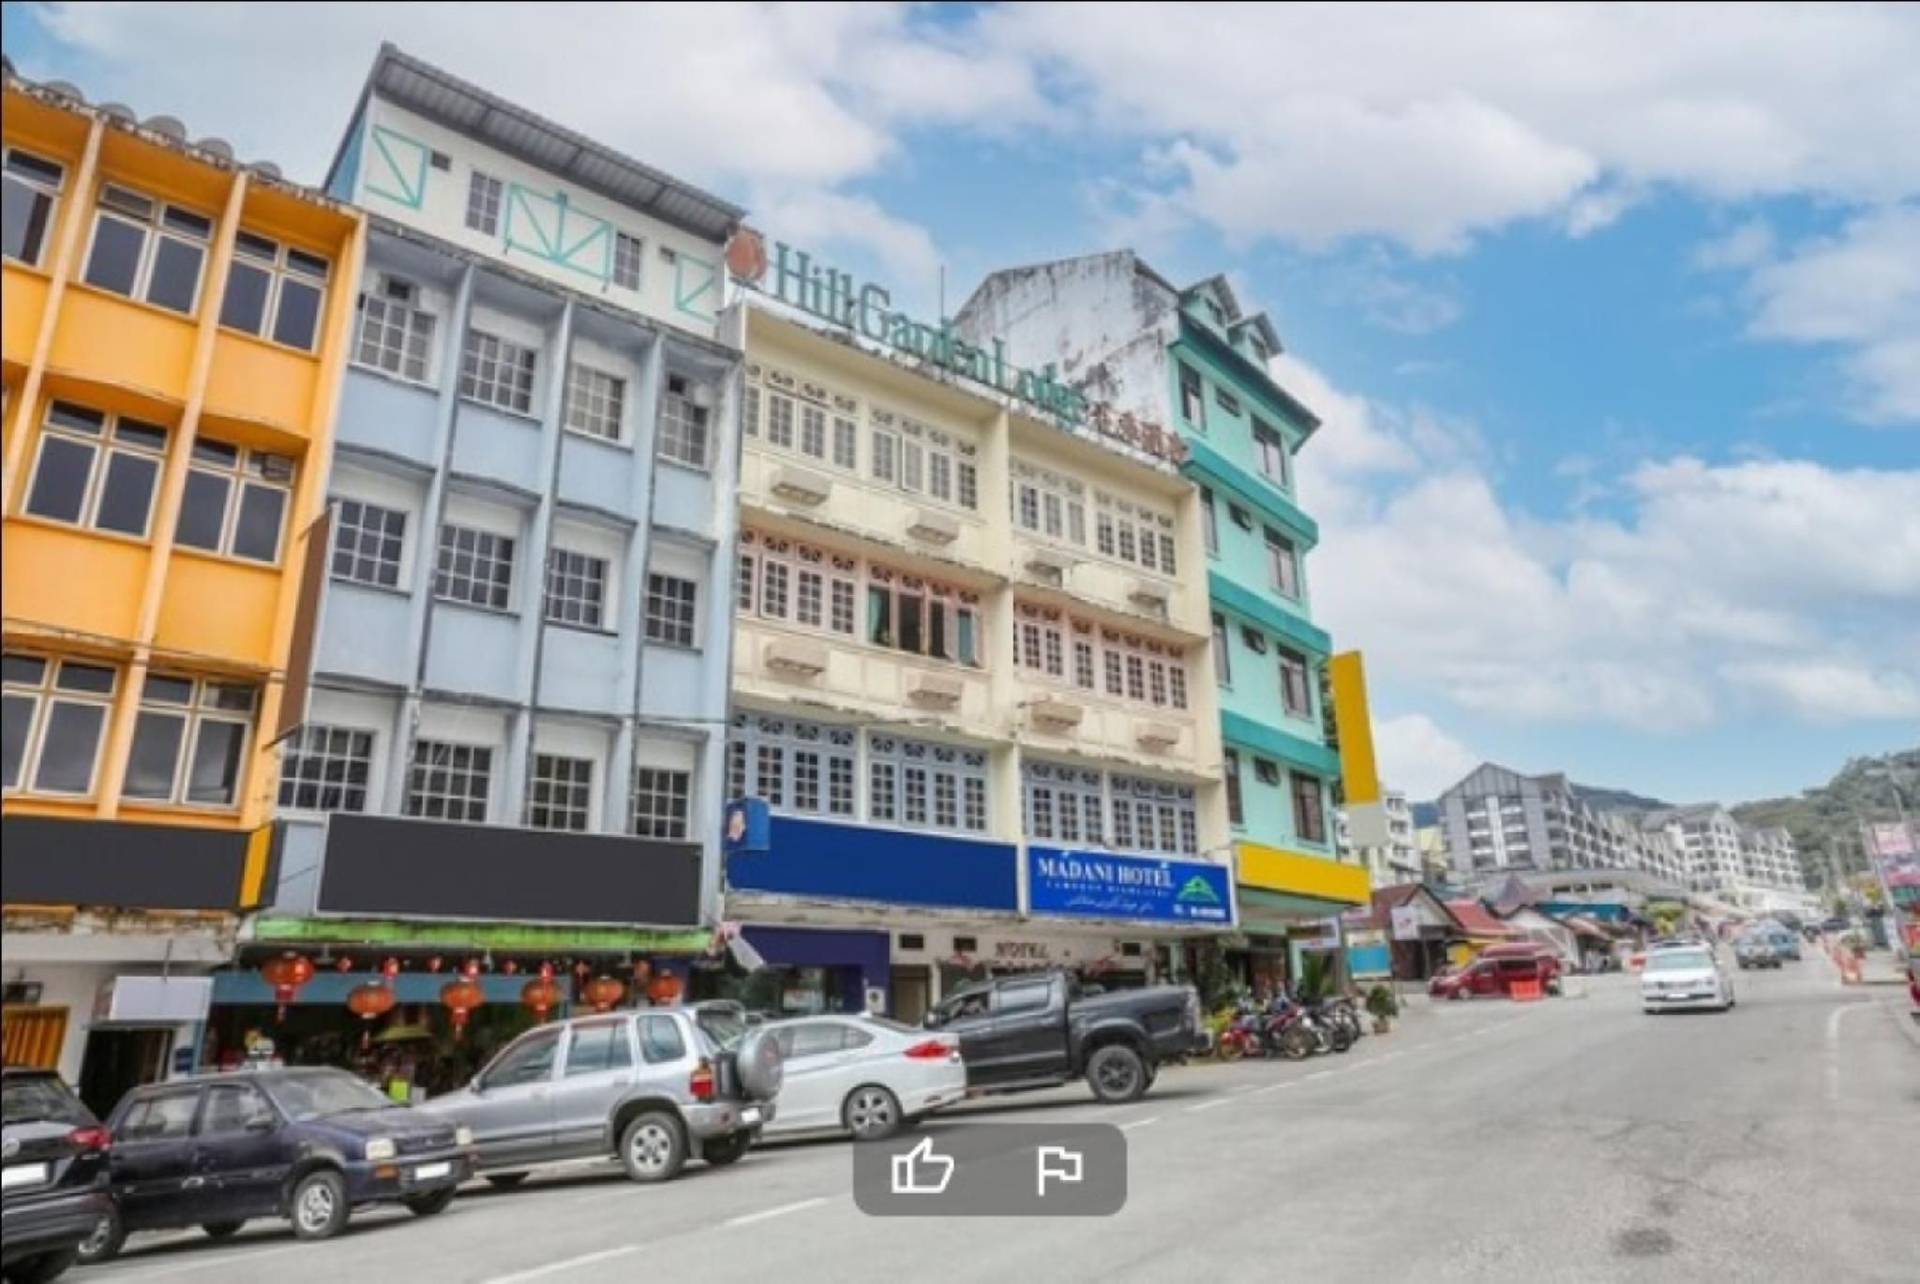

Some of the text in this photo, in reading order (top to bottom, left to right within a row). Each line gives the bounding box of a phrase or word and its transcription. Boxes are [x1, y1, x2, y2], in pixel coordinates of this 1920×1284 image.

[775, 241, 854, 328] Hill
[1038, 857, 1114, 883] MADANI
[1118, 865, 1174, 889] HOTEL
